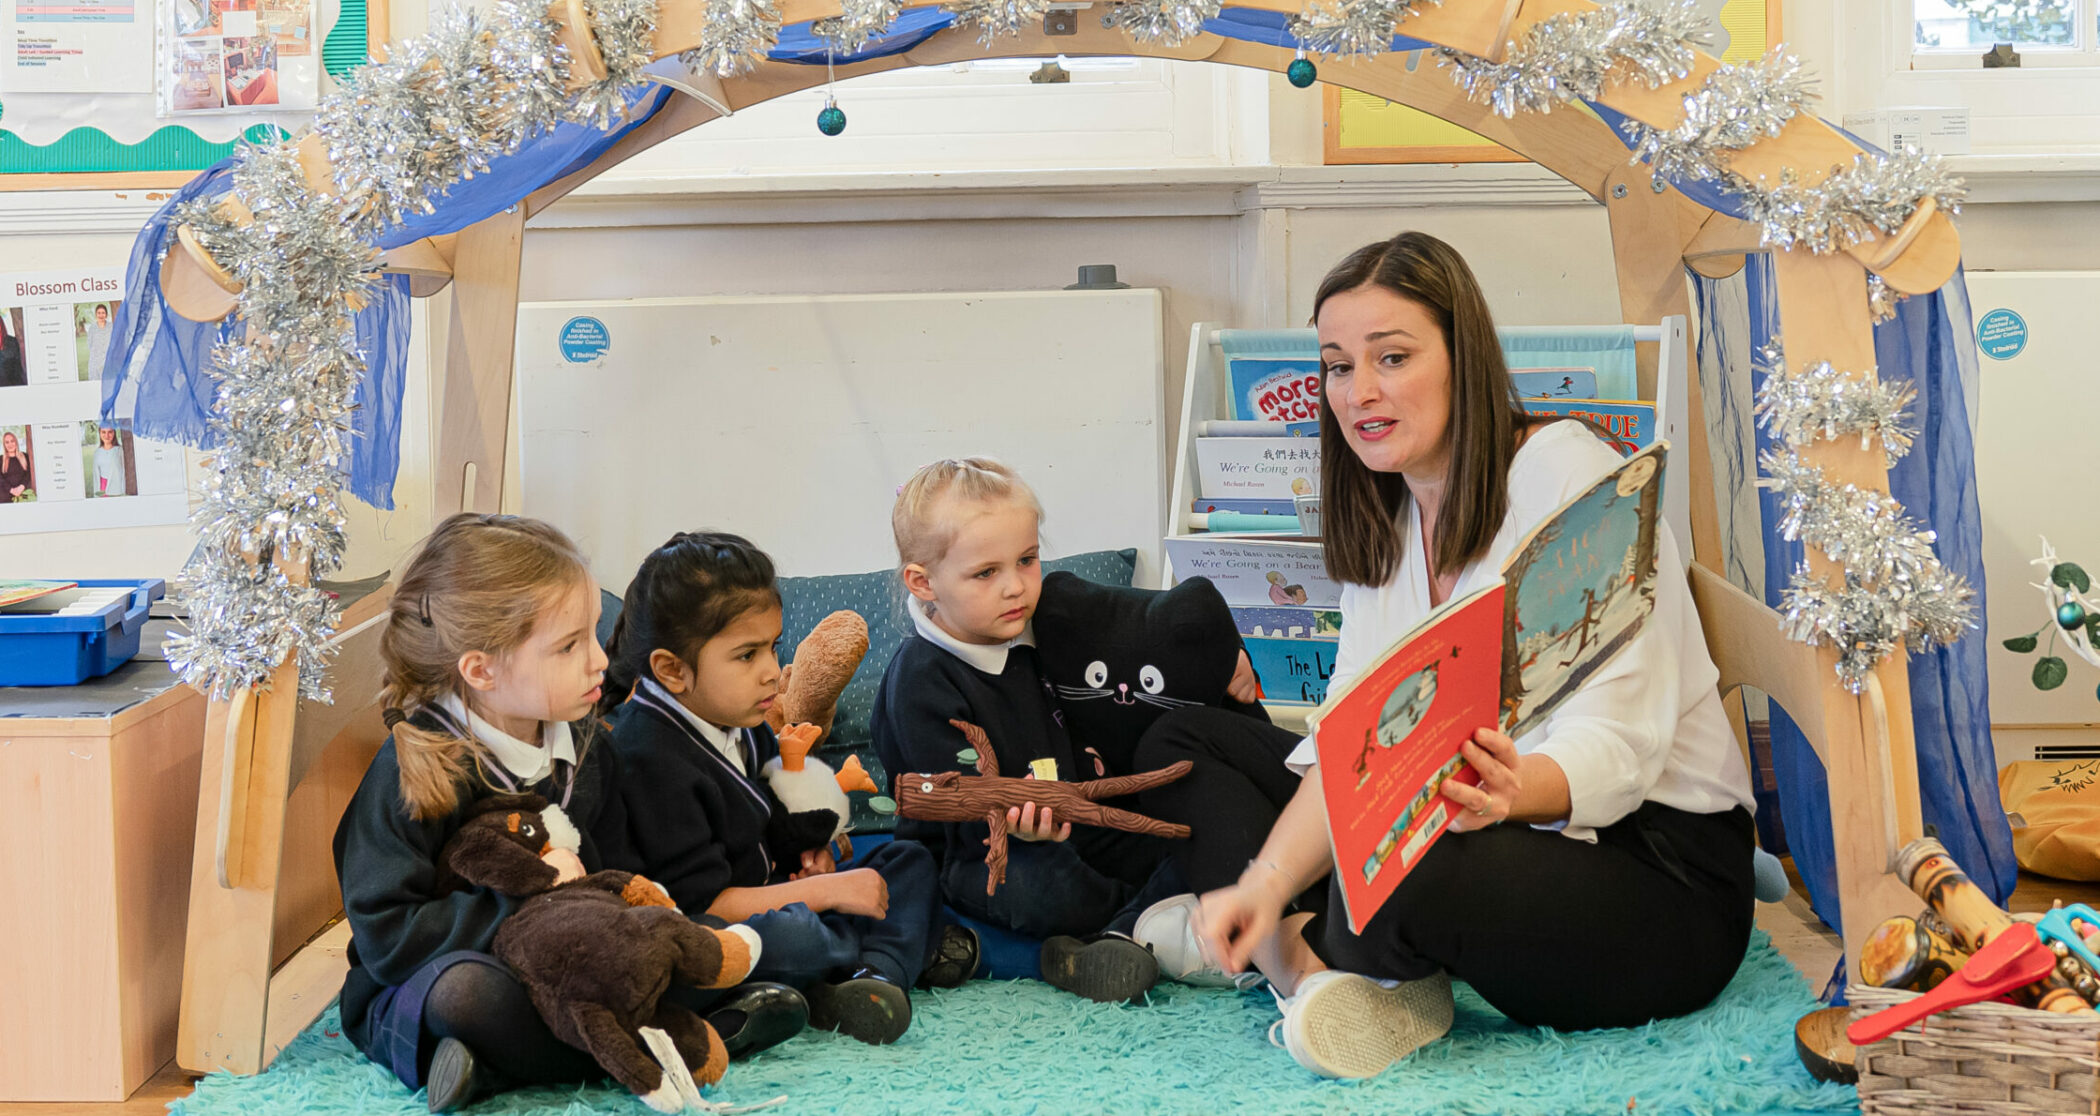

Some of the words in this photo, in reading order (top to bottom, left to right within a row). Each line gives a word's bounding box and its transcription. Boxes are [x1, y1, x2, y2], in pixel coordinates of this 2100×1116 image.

[16, 282, 76, 296] Blossom
[80, 277, 118, 292] Class
[1258, 376, 1320, 414] more
[1268, 399, 1320, 421] tch
[1220, 462, 1250, 474] We're
[1255, 463, 1288, 475] Going
[1294, 466, 1308, 474] on
[1191, 560, 1221, 568] We're
[1226, 560, 1260, 570] Going
[1296, 562, 1322, 570] Bear
[1286, 654, 1311, 676] The
